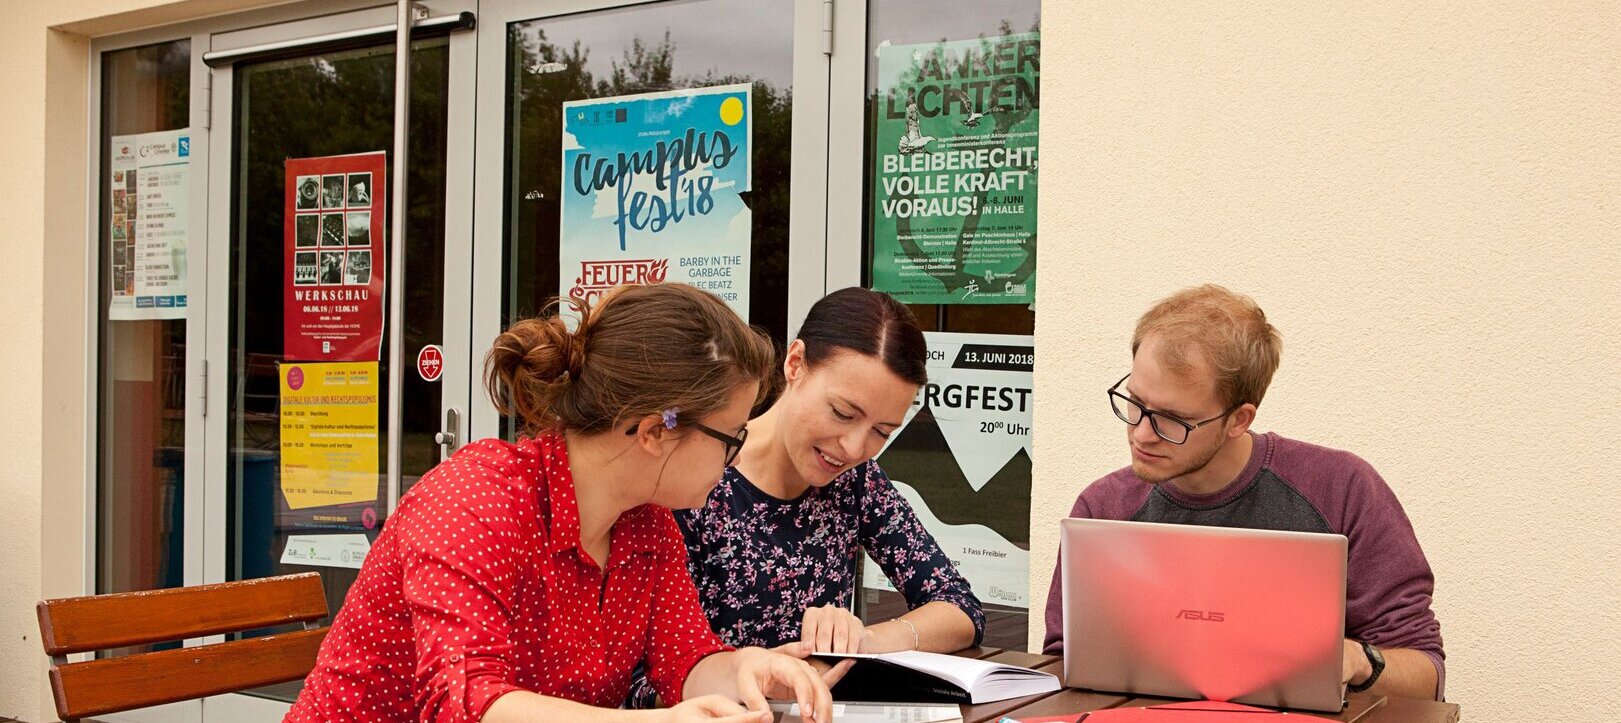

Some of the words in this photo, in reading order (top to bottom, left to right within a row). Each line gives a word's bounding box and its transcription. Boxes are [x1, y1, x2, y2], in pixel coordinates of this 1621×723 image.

[916, 40, 1040, 82] ANKER
[887, 77, 1040, 120] LICHTEN
[883, 147, 1038, 173] BLEIBERECHT,
[882, 174, 949, 196] VOLLE
[954, 171, 1028, 193] KRAFT
[1003, 195, 1024, 204] JUNI
[881, 196, 978, 218] VORAUS!
[982, 206, 992, 214] IN
[994, 205, 1024, 214] HALLE
[680, 257, 710, 267] BARBY
[711, 257, 720, 266] IN
[721, 256, 741, 265] THE
[581, 261, 649, 286] FEUER
[689, 268, 731, 277] GARBAGE
[708, 280, 732, 289] BEATZ
[295, 290, 368, 301] WERKSCHAU
[965, 352, 980, 362] 13.
[982, 353, 1006, 364] JUNI
[1008, 354, 1034, 365] 2018
[1007, 423, 1029, 436] Uhr
[968, 548, 981, 556] Fass
[982, 549, 1007, 559] Freibier
[1175, 609, 1224, 622] ASUS
